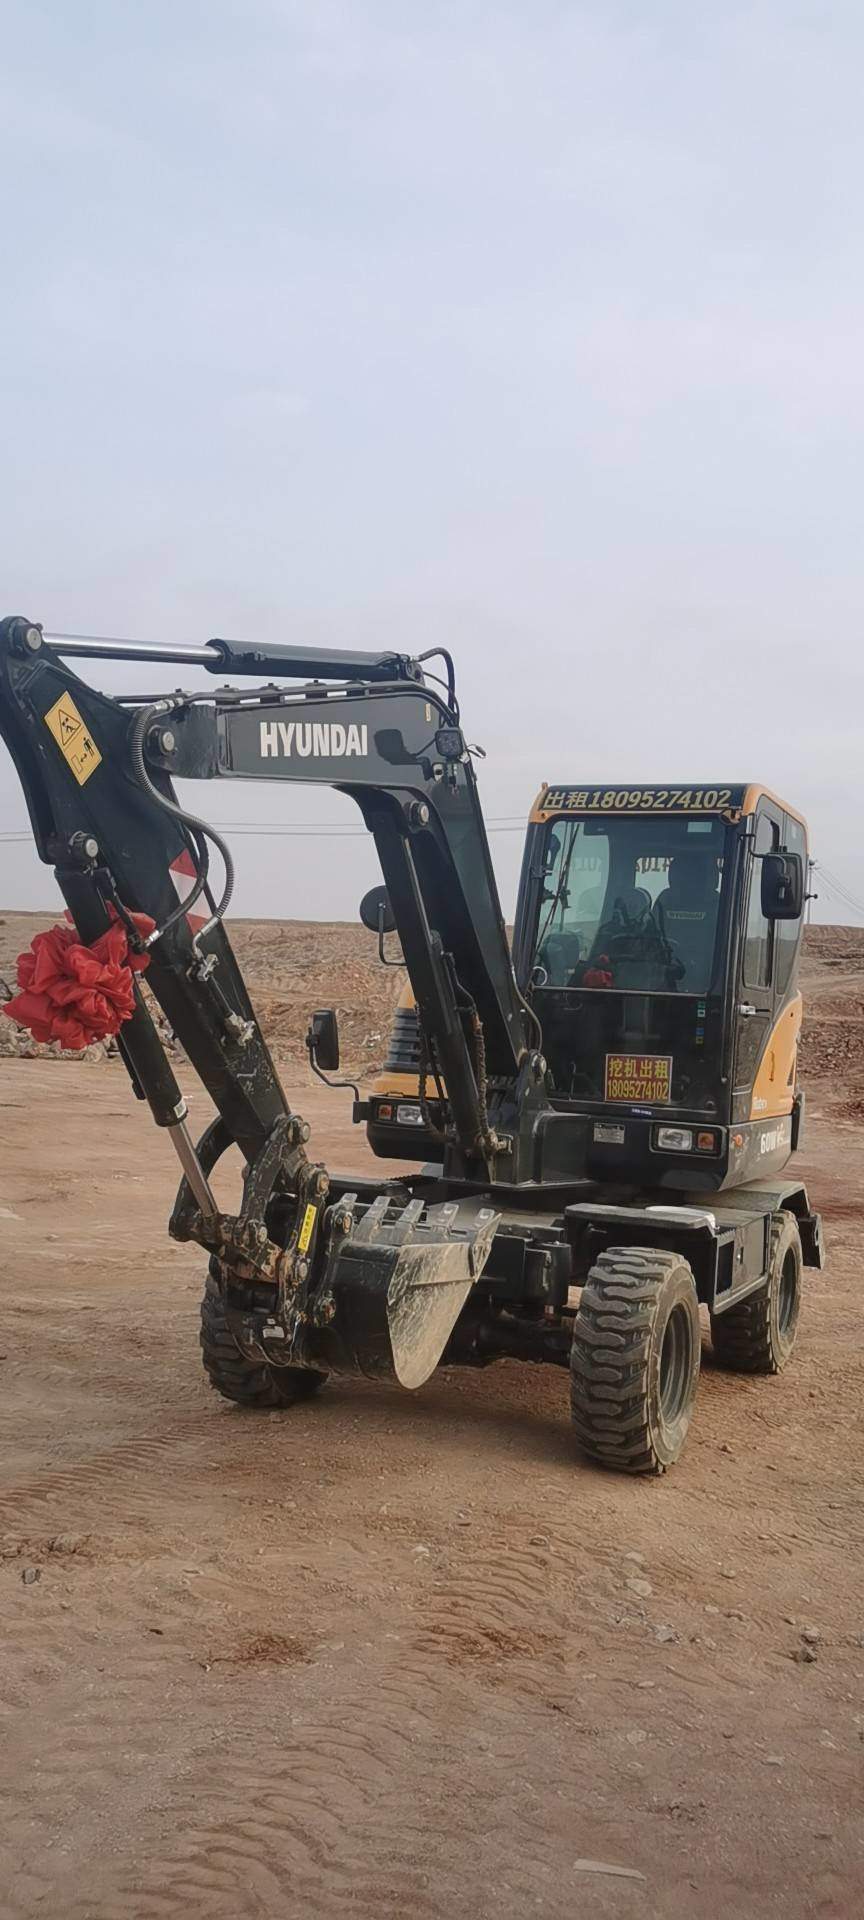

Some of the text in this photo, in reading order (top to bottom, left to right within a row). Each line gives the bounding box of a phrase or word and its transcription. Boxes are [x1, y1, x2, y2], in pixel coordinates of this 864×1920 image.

[260, 722, 368, 757] HYUNDAI
[609, 1058, 668, 1078] 挖机出租
[608, 1079, 669, 1100] 18095274102
